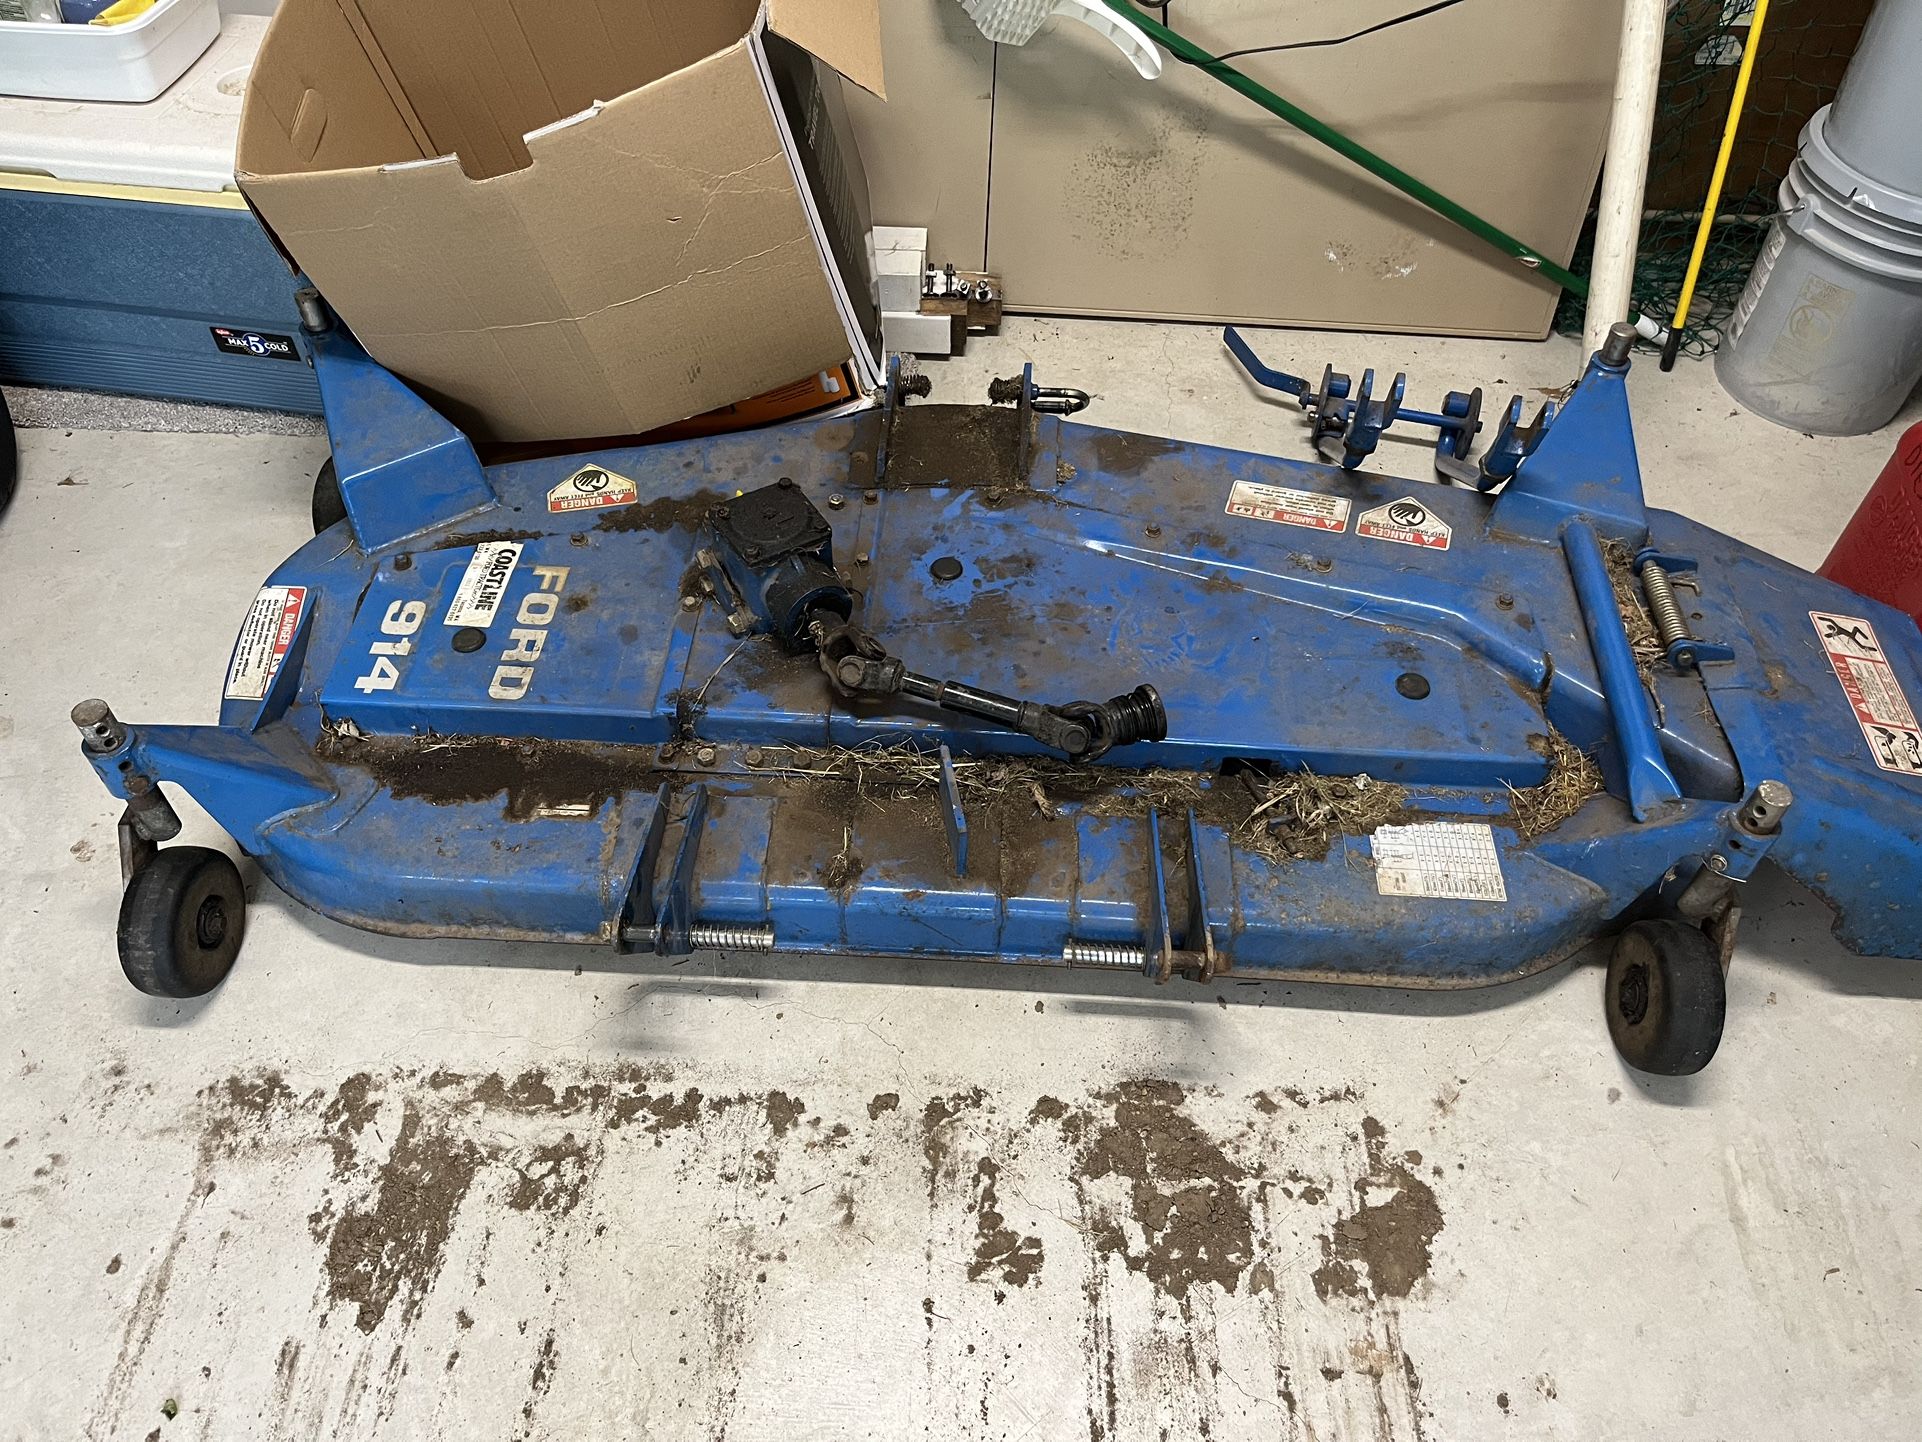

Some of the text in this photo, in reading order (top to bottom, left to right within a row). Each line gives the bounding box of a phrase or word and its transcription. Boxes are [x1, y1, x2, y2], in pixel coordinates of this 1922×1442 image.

[228, 336, 289, 353] MAX 5 COLD
[560, 496, 602, 508] DANGER
[1282, 513, 1317, 524] DANGER
[1368, 526, 1413, 541] DANGER
[264, 599, 272, 613] when
[251, 617, 261, 636] operate
[265, 617, 274, 632] stand
[279, 613, 296, 646] DANGER
[488, 565, 571, 700] FORD
[246, 638, 254, 655] mower
[354, 600, 427, 694] 914
[256, 647, 266, 668] machine
[240, 657, 250, 677] without
